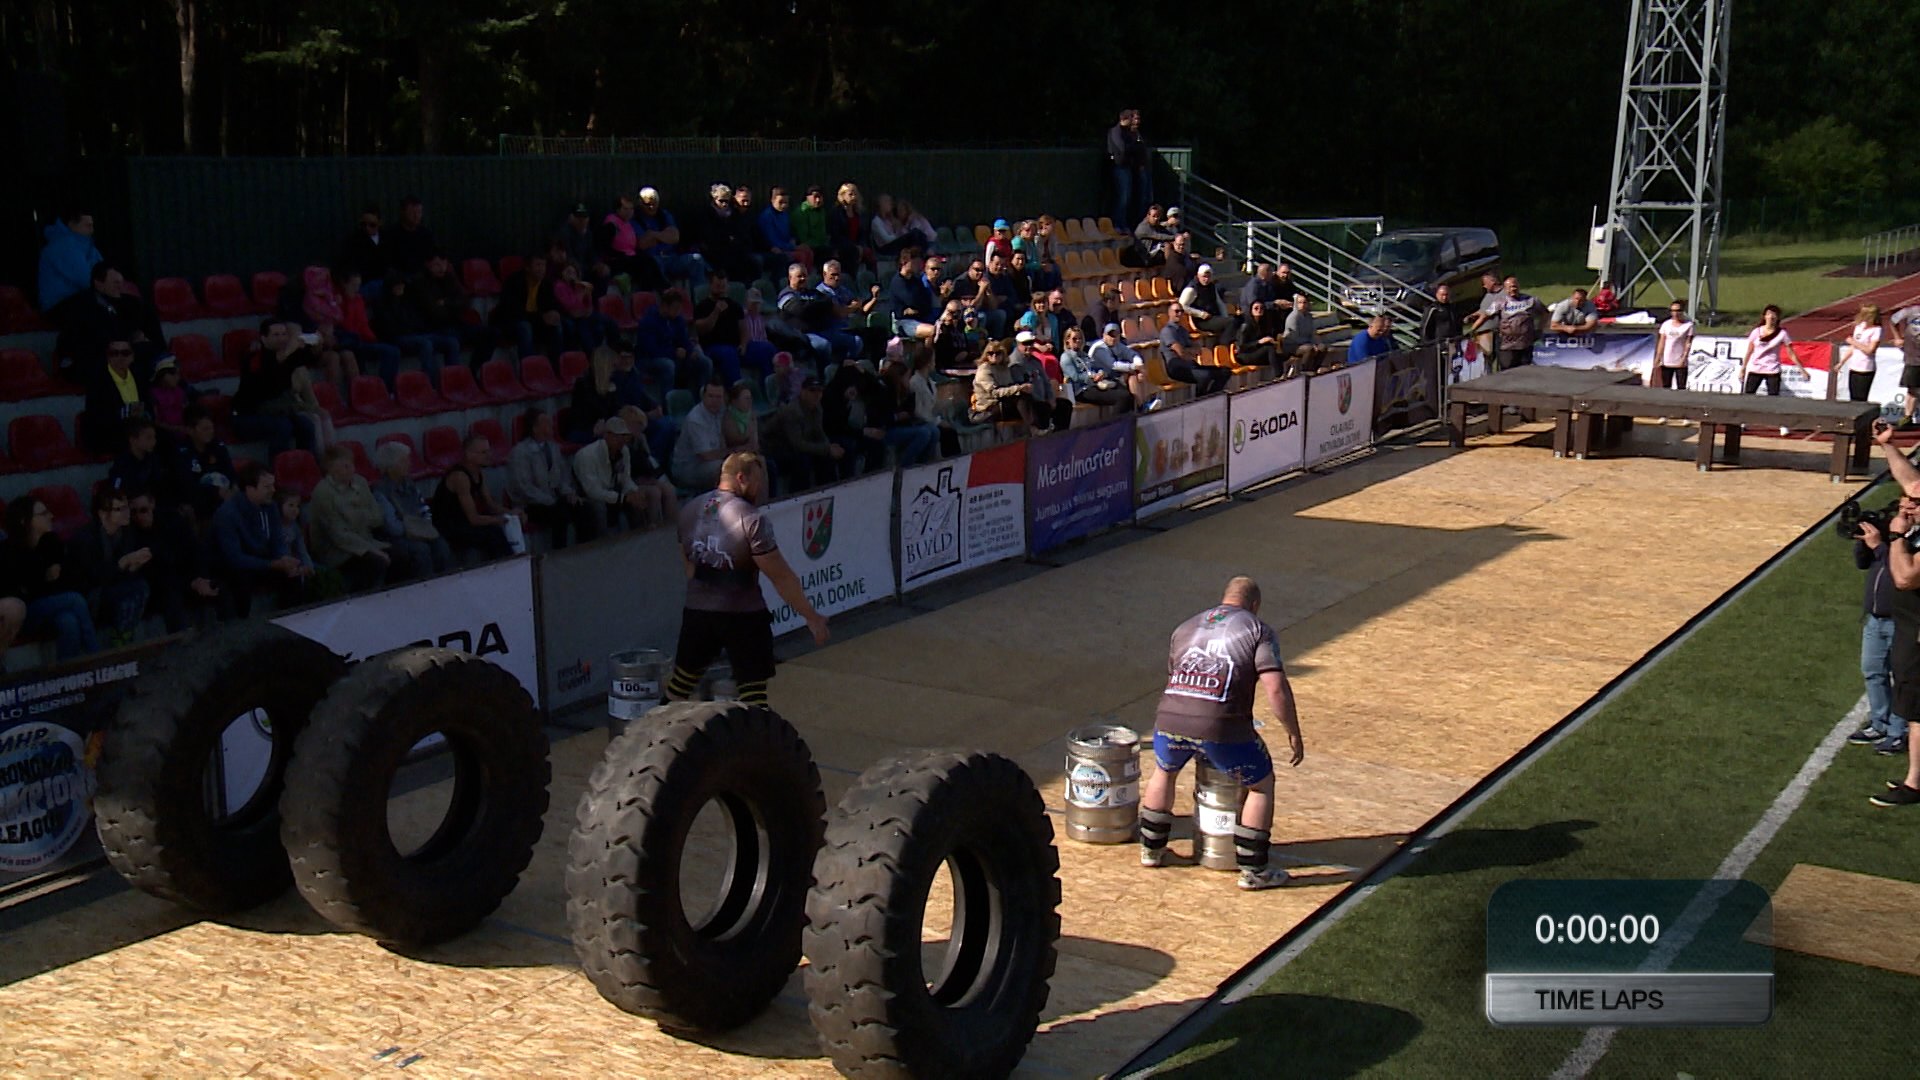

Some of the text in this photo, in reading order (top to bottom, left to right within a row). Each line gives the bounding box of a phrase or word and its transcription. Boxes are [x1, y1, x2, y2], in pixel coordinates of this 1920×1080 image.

[1544, 337, 1596, 349] FLOW
[1249, 410, 1299, 441] ŠKODA
[1037, 446, 1120, 490] Metalmaster
[801, 562, 843, 590] LAINES
[827, 578, 867, 606] DOME
[17, 670, 94, 702] CHAMPIONS
[95, 660, 140, 684] LEAGUE
[1169, 673, 1220, 689] BUILD
